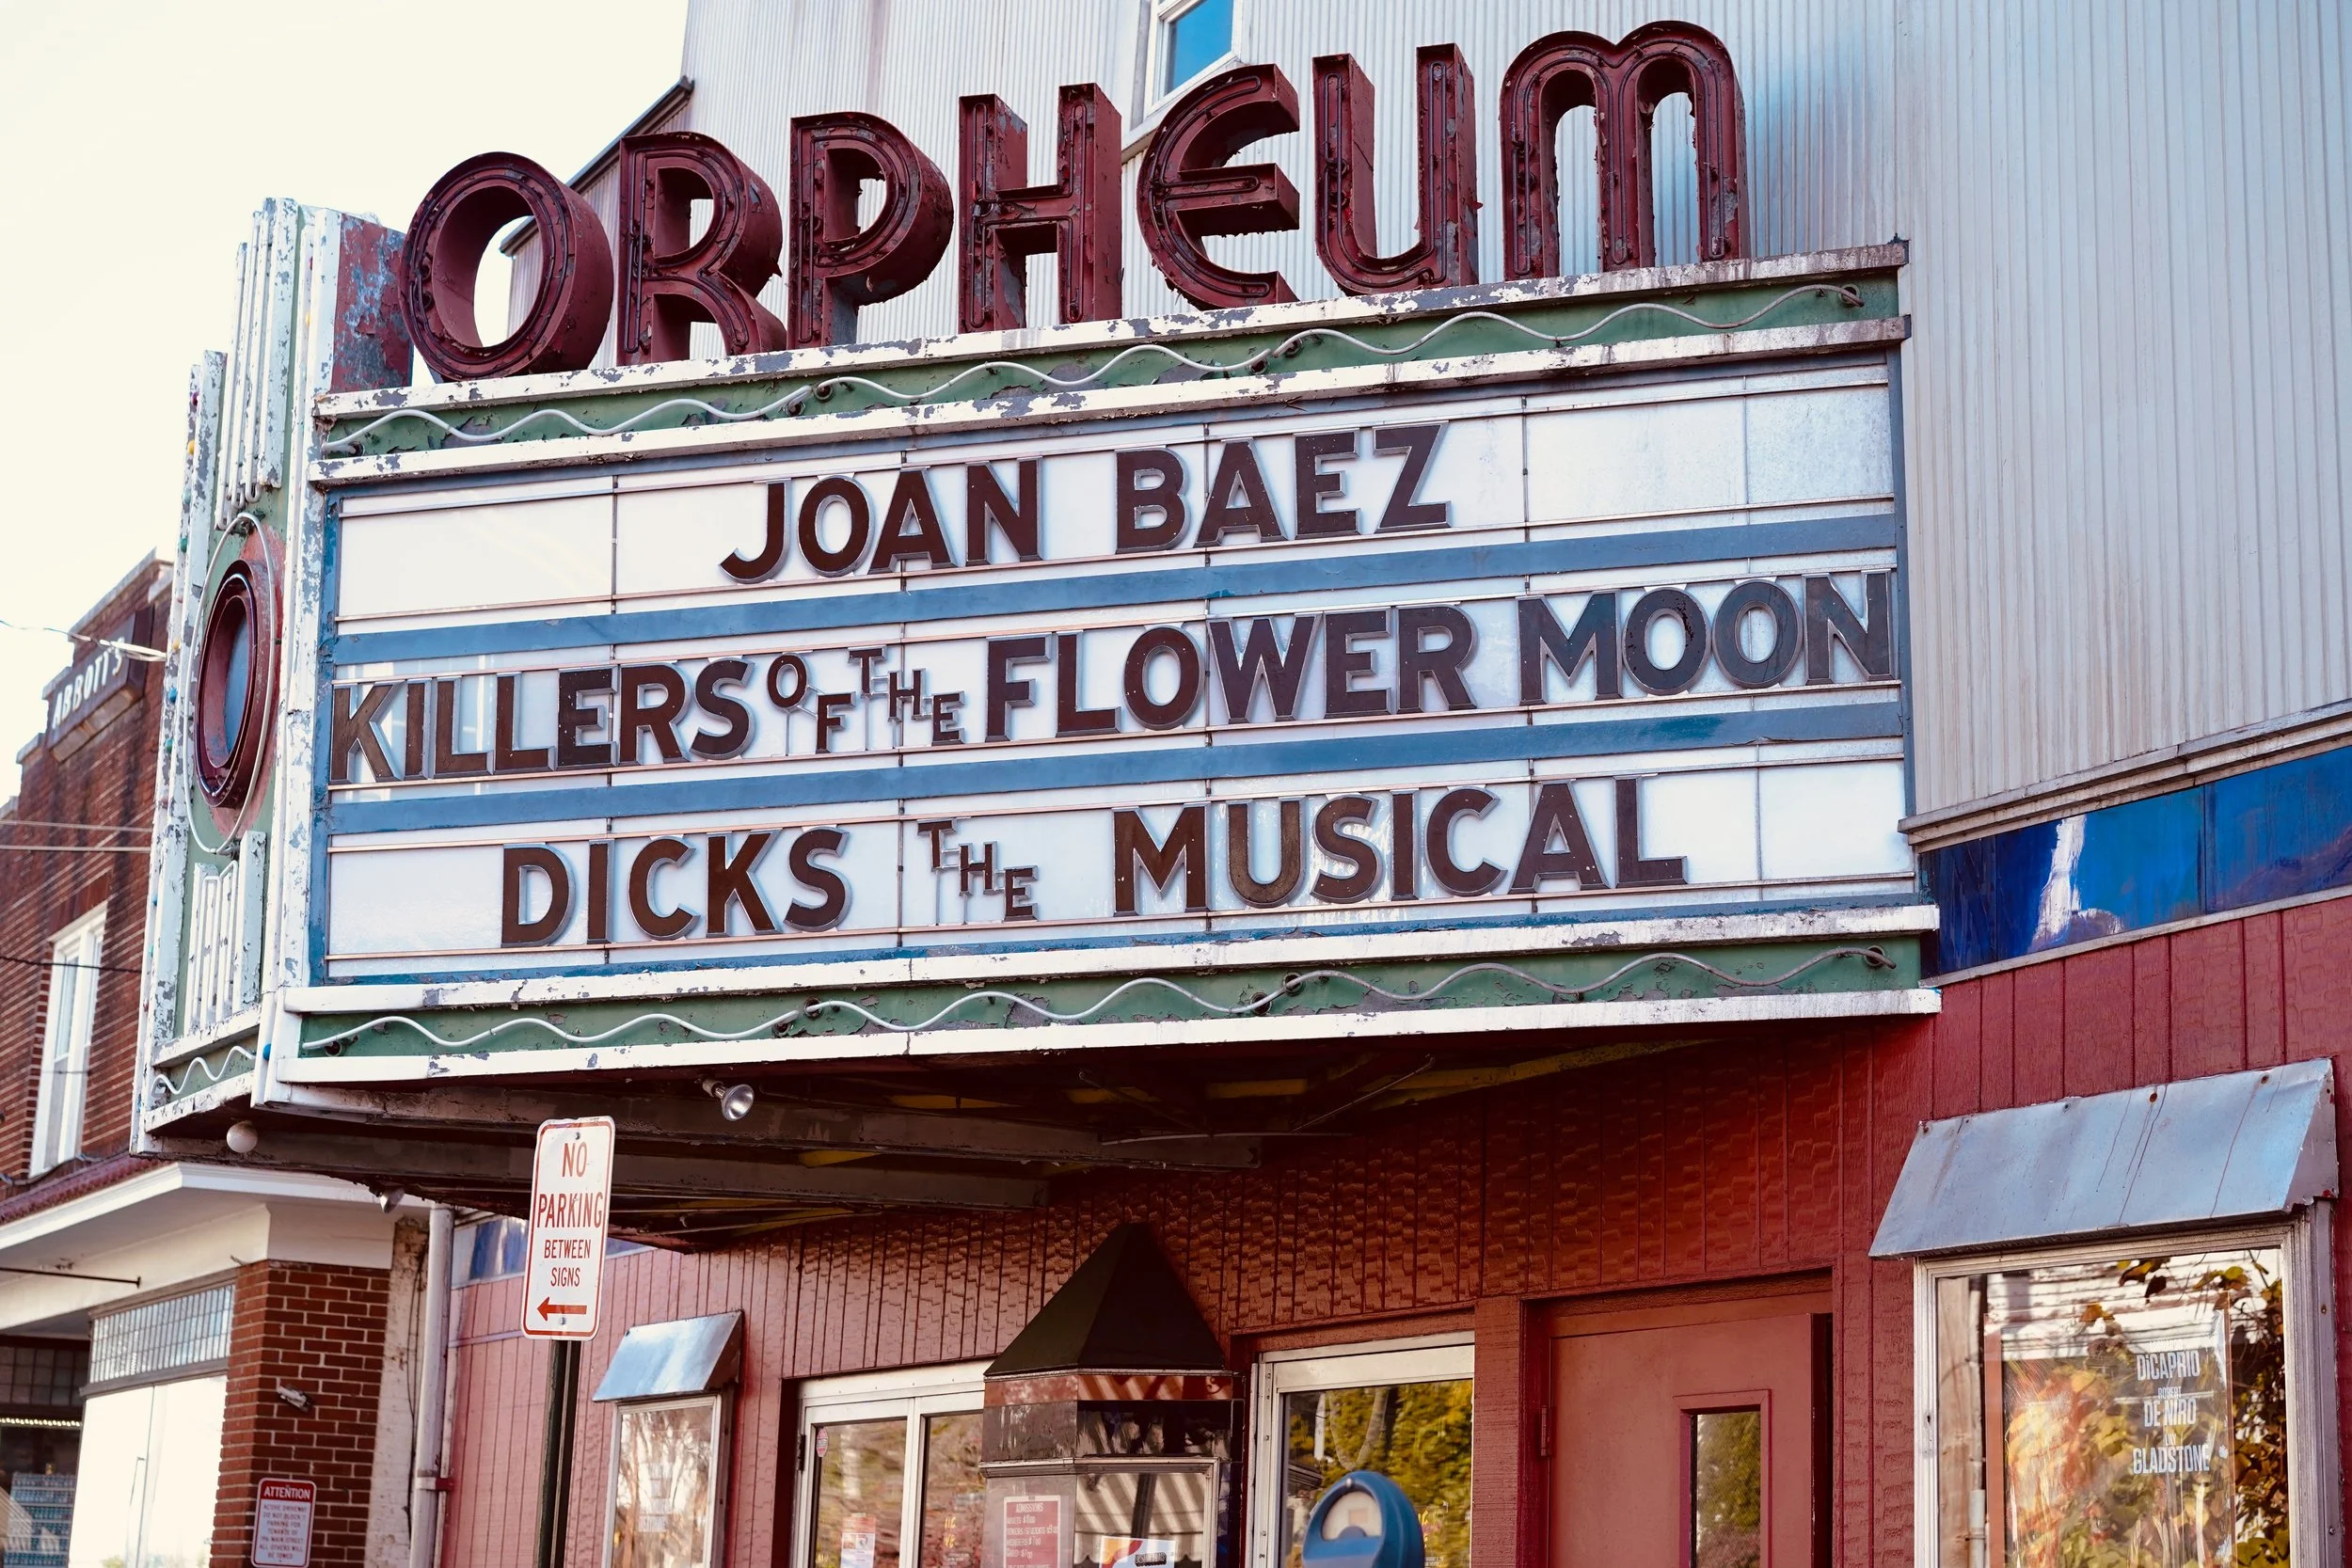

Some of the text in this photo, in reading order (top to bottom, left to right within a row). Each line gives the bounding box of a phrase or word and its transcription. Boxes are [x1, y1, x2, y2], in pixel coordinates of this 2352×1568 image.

[397, 20, 1752, 383] ORPHEUM
[719, 420, 1452, 584] JOAN BAEZ
[330, 568, 1897, 784] KILLERS OF THE FLOWER MOON
[501, 773, 1690, 947] DICKS THE MUSICAL
[562, 1141, 587, 1178] NO
[536, 1191, 604, 1228] PARKING
[544, 1239, 592, 1259] BETWEEN
[550, 1266, 580, 1288] SIGNS
[2157, 1386, 2183, 1400] ROBERT
[2144, 1398, 2197, 1427] DE NIRO
[2133, 1444, 2210, 1476] GLADSTONE
[264, 1486, 310, 1499] ATTENTION
[1016, 1502, 1044, 1513] ADMISSIONS
